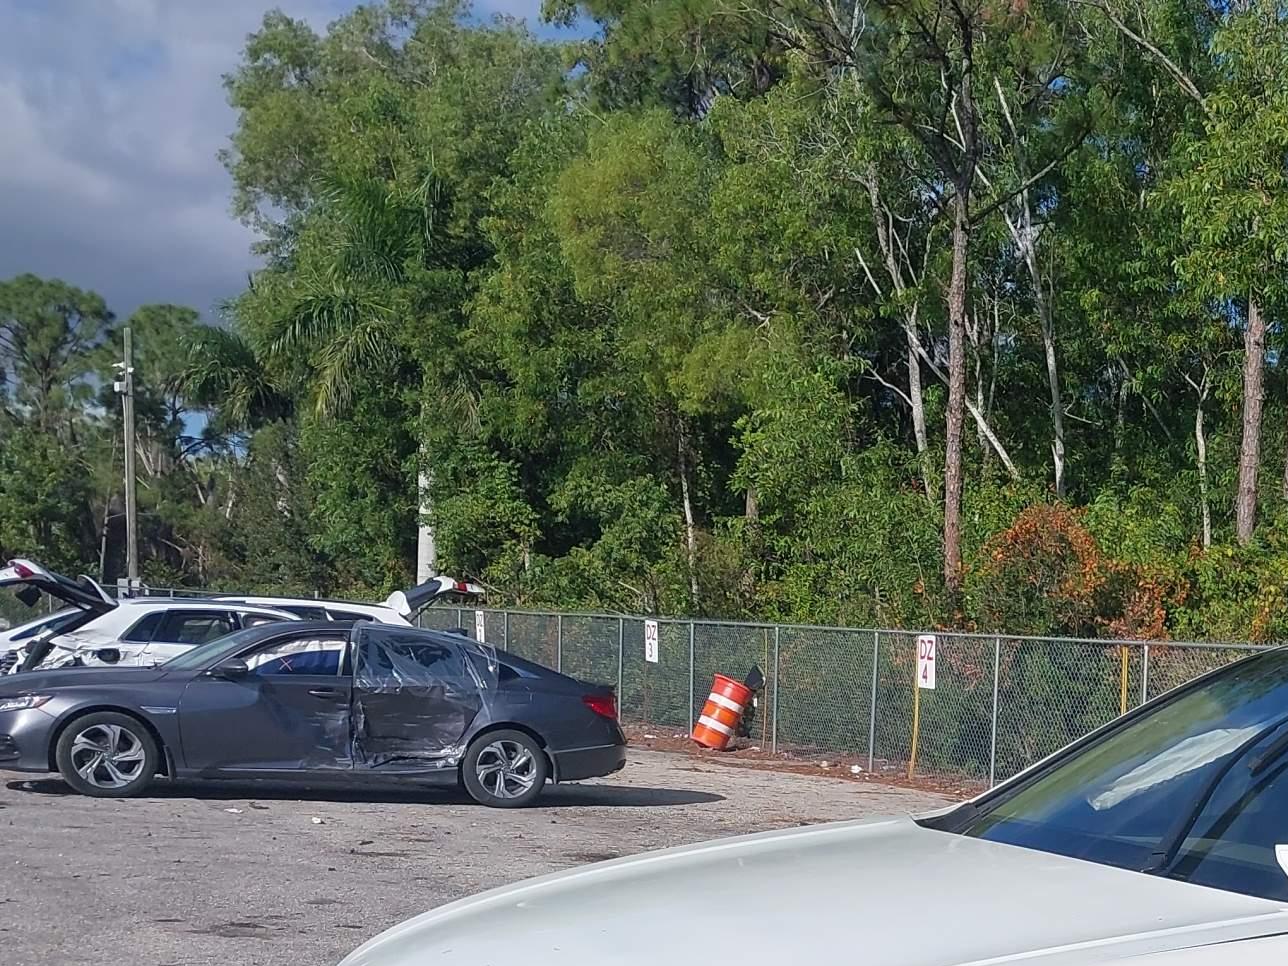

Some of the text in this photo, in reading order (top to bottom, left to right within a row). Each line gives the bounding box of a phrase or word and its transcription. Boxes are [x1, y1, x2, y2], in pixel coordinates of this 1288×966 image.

[646, 624, 657, 641] DZ
[648, 642, 653, 658] 3
[919, 639, 934, 660] DZ
[921, 663, 928, 683] 4
